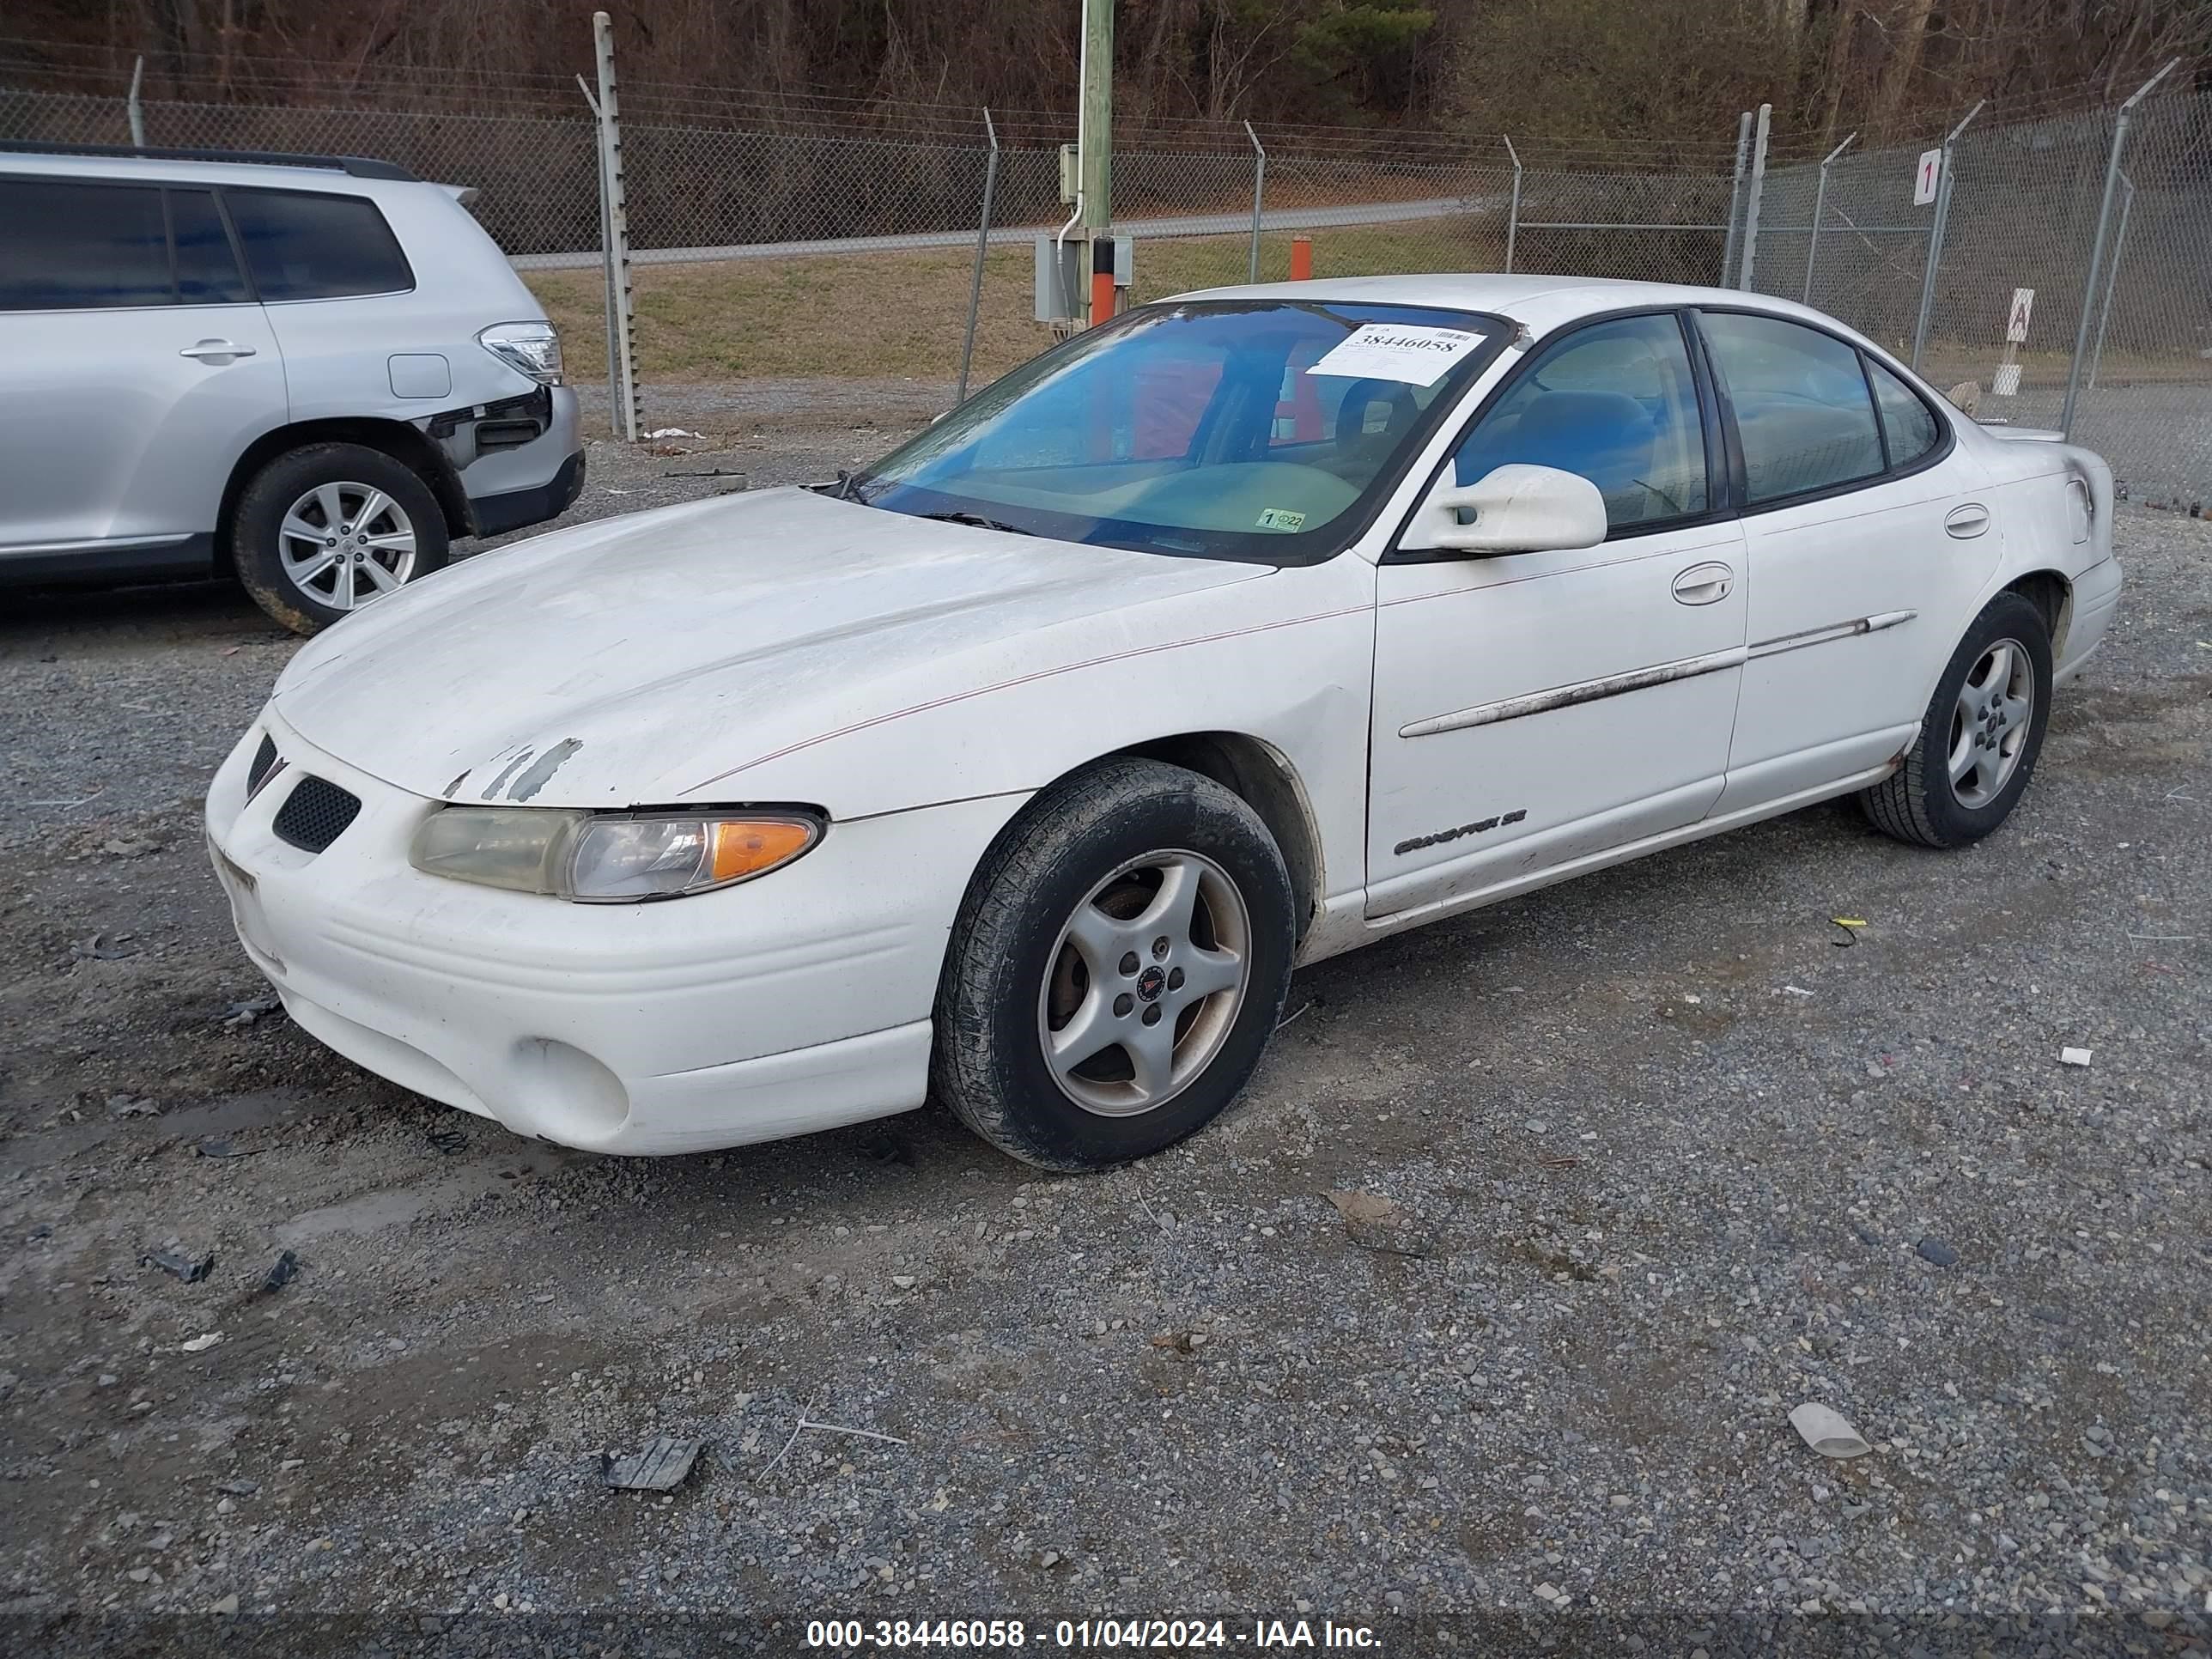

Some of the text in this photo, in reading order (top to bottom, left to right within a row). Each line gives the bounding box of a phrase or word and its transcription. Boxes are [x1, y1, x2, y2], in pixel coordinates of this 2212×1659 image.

[1924, 161, 1932, 194] 1
[2011, 303, 2027, 331] A
[1354, 334, 1458, 353] 38446058
[1266, 513, 1302, 526] 1 22
